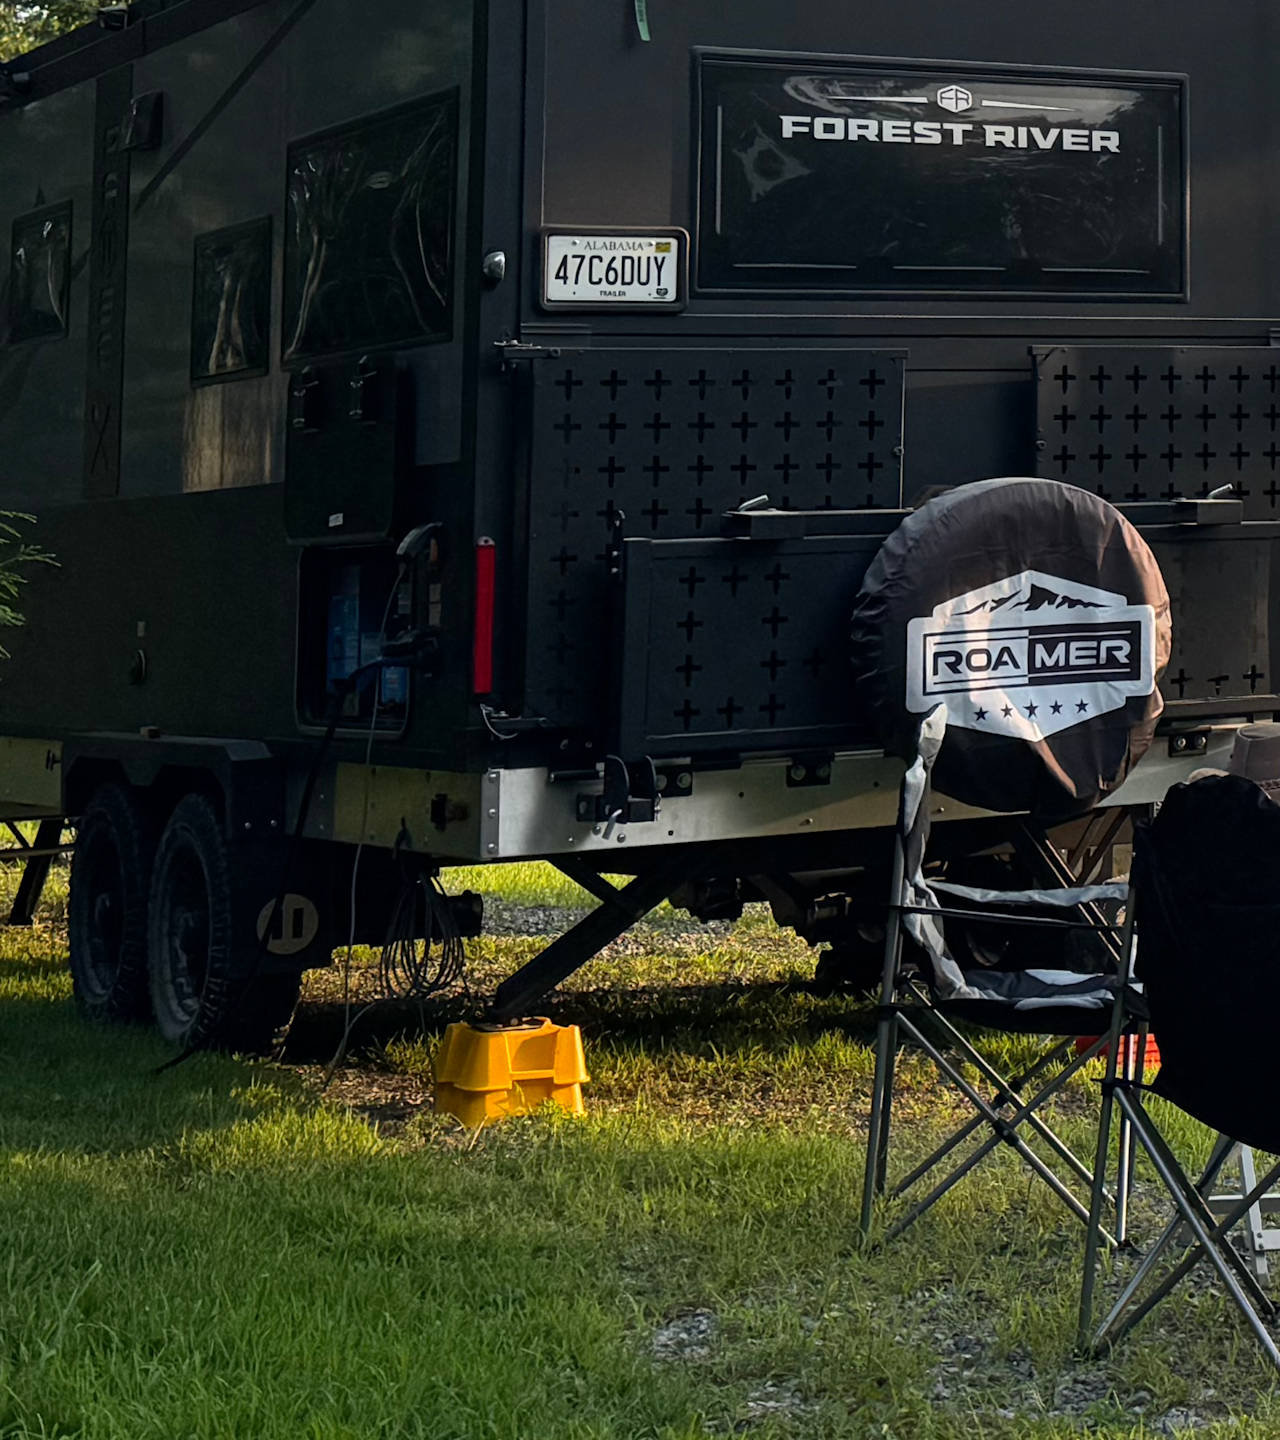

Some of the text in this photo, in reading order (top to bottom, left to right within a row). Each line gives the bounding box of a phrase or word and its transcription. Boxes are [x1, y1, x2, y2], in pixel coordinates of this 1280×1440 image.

[779, 114, 1121, 154] FOREST RIVER
[584, 241, 644, 252] ALABAMA
[555, 254, 666, 286] 47C6DUY
[932, 639, 1132, 676] ROAMER
